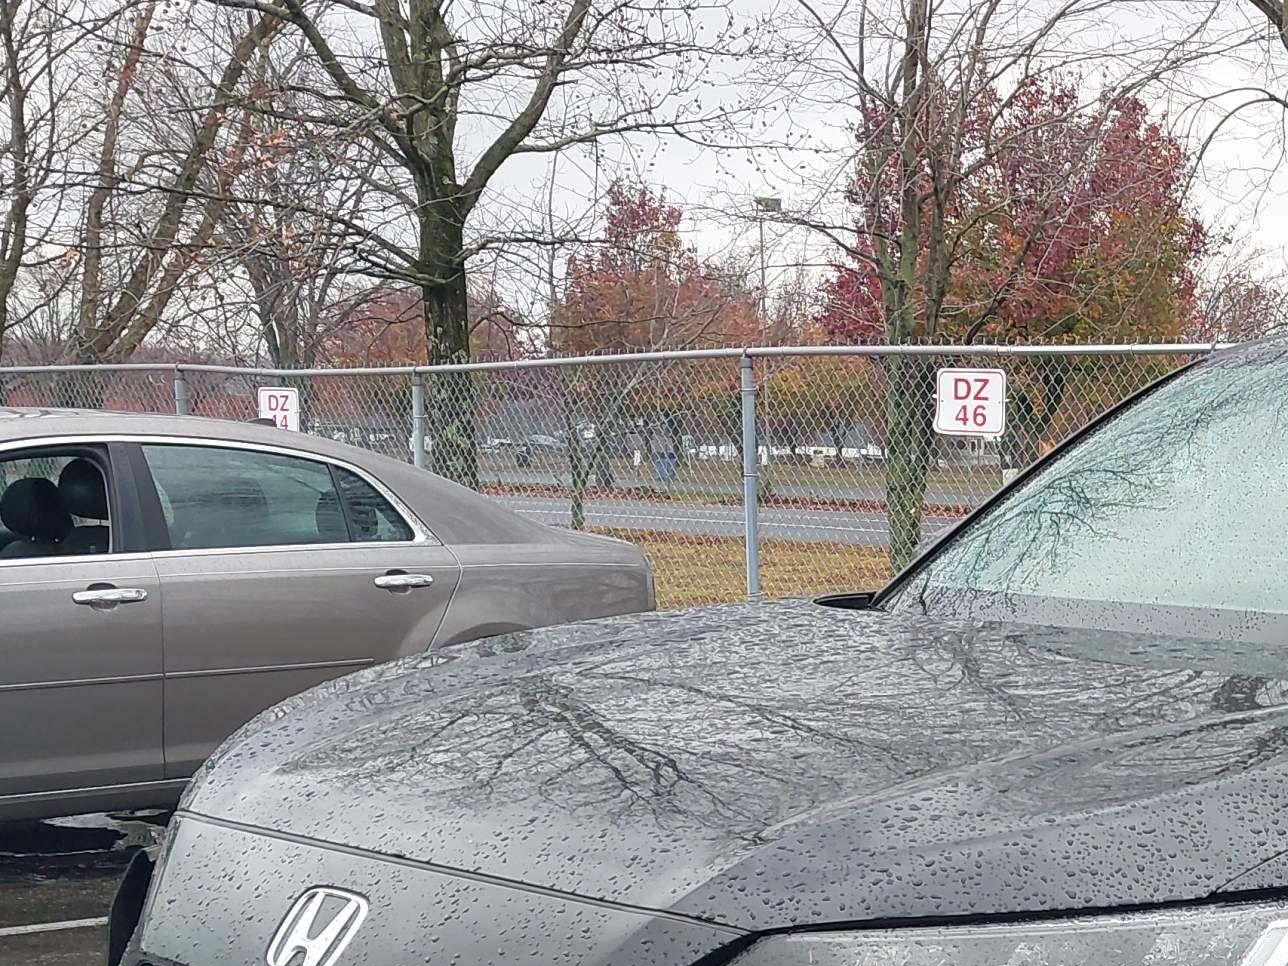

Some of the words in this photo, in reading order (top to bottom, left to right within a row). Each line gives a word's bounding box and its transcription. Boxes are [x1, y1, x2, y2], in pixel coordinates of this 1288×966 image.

[954, 378, 990, 401] DZ
[267, 395, 289, 411] DZ
[955, 405, 987, 427] 46
